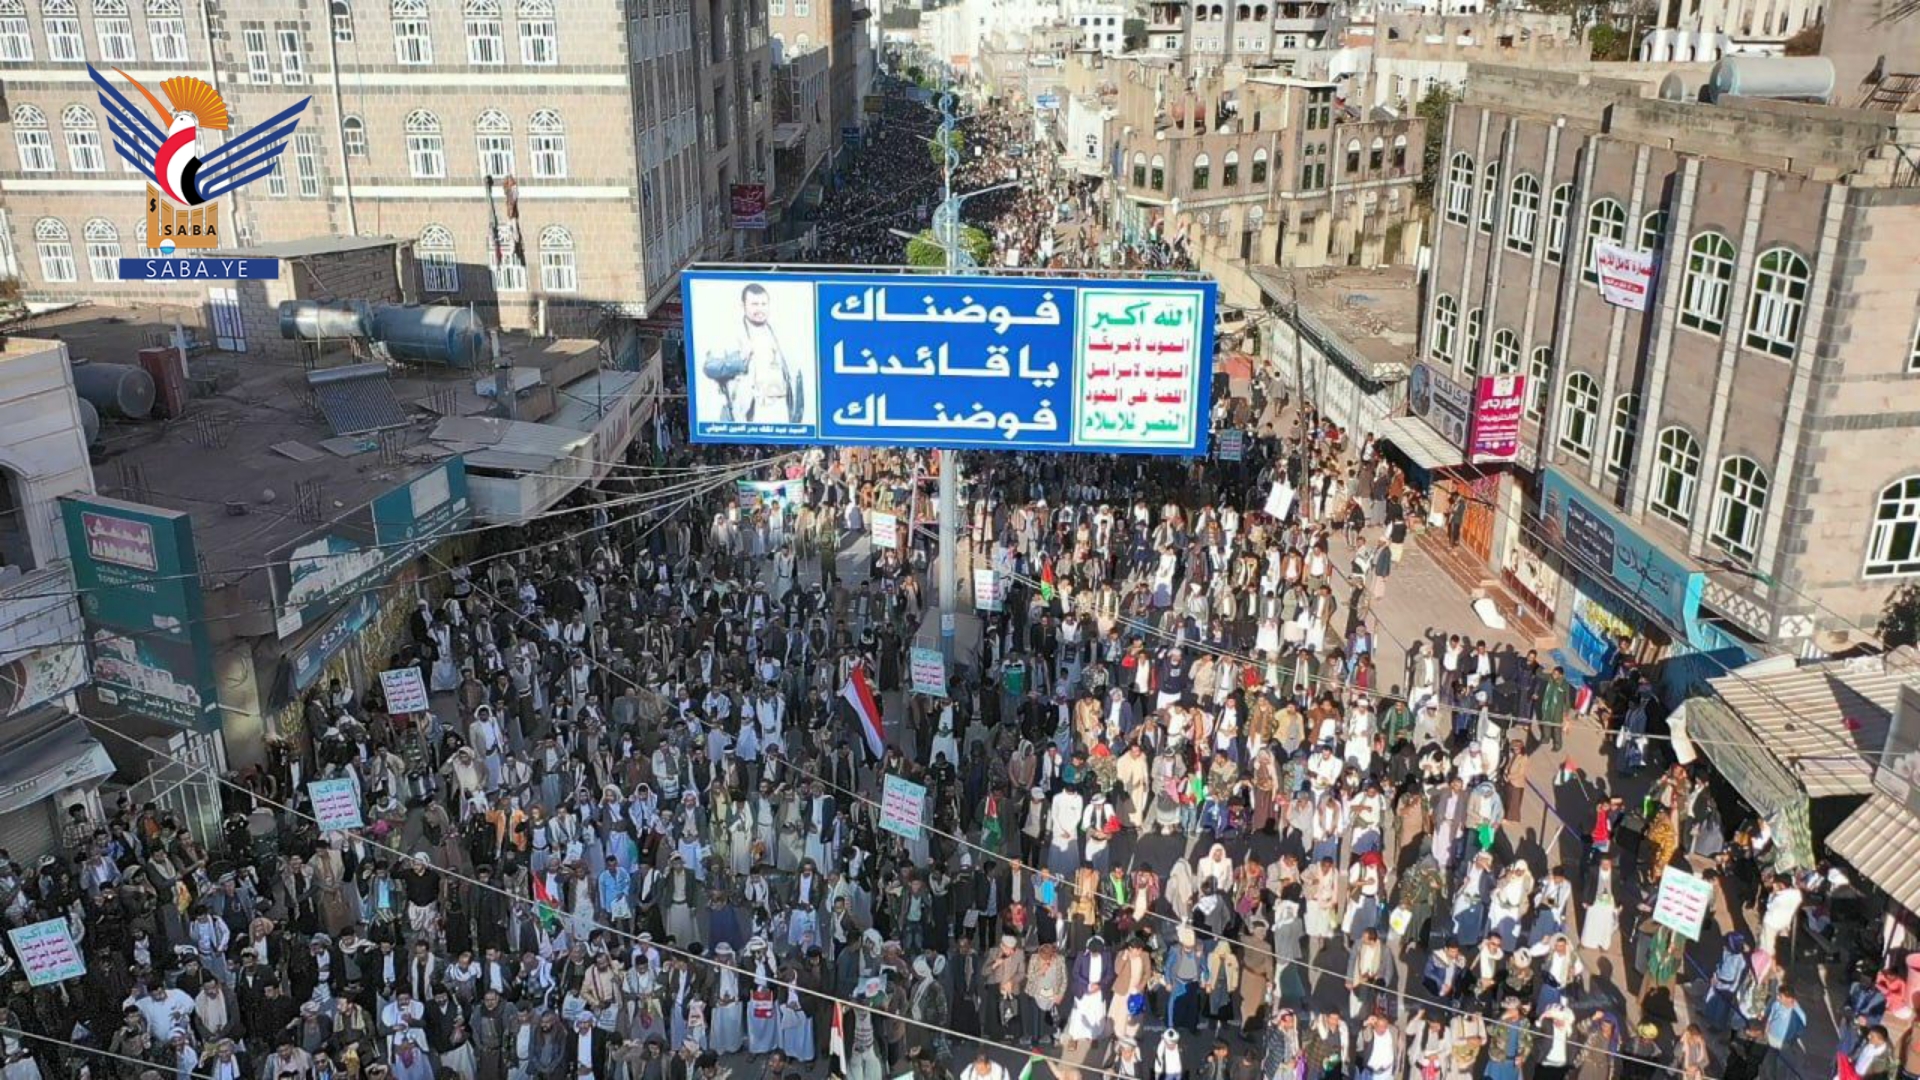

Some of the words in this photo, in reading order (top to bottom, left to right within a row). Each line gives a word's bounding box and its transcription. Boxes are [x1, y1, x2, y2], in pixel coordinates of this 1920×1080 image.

[830, 287, 1061, 334] فوضناك
[1154, 302, 1192, 326] الله
[833, 339, 1010, 377] قائدنا
[1018, 344, 1060, 388] يا
[832, 393, 1058, 440] فوضناك
